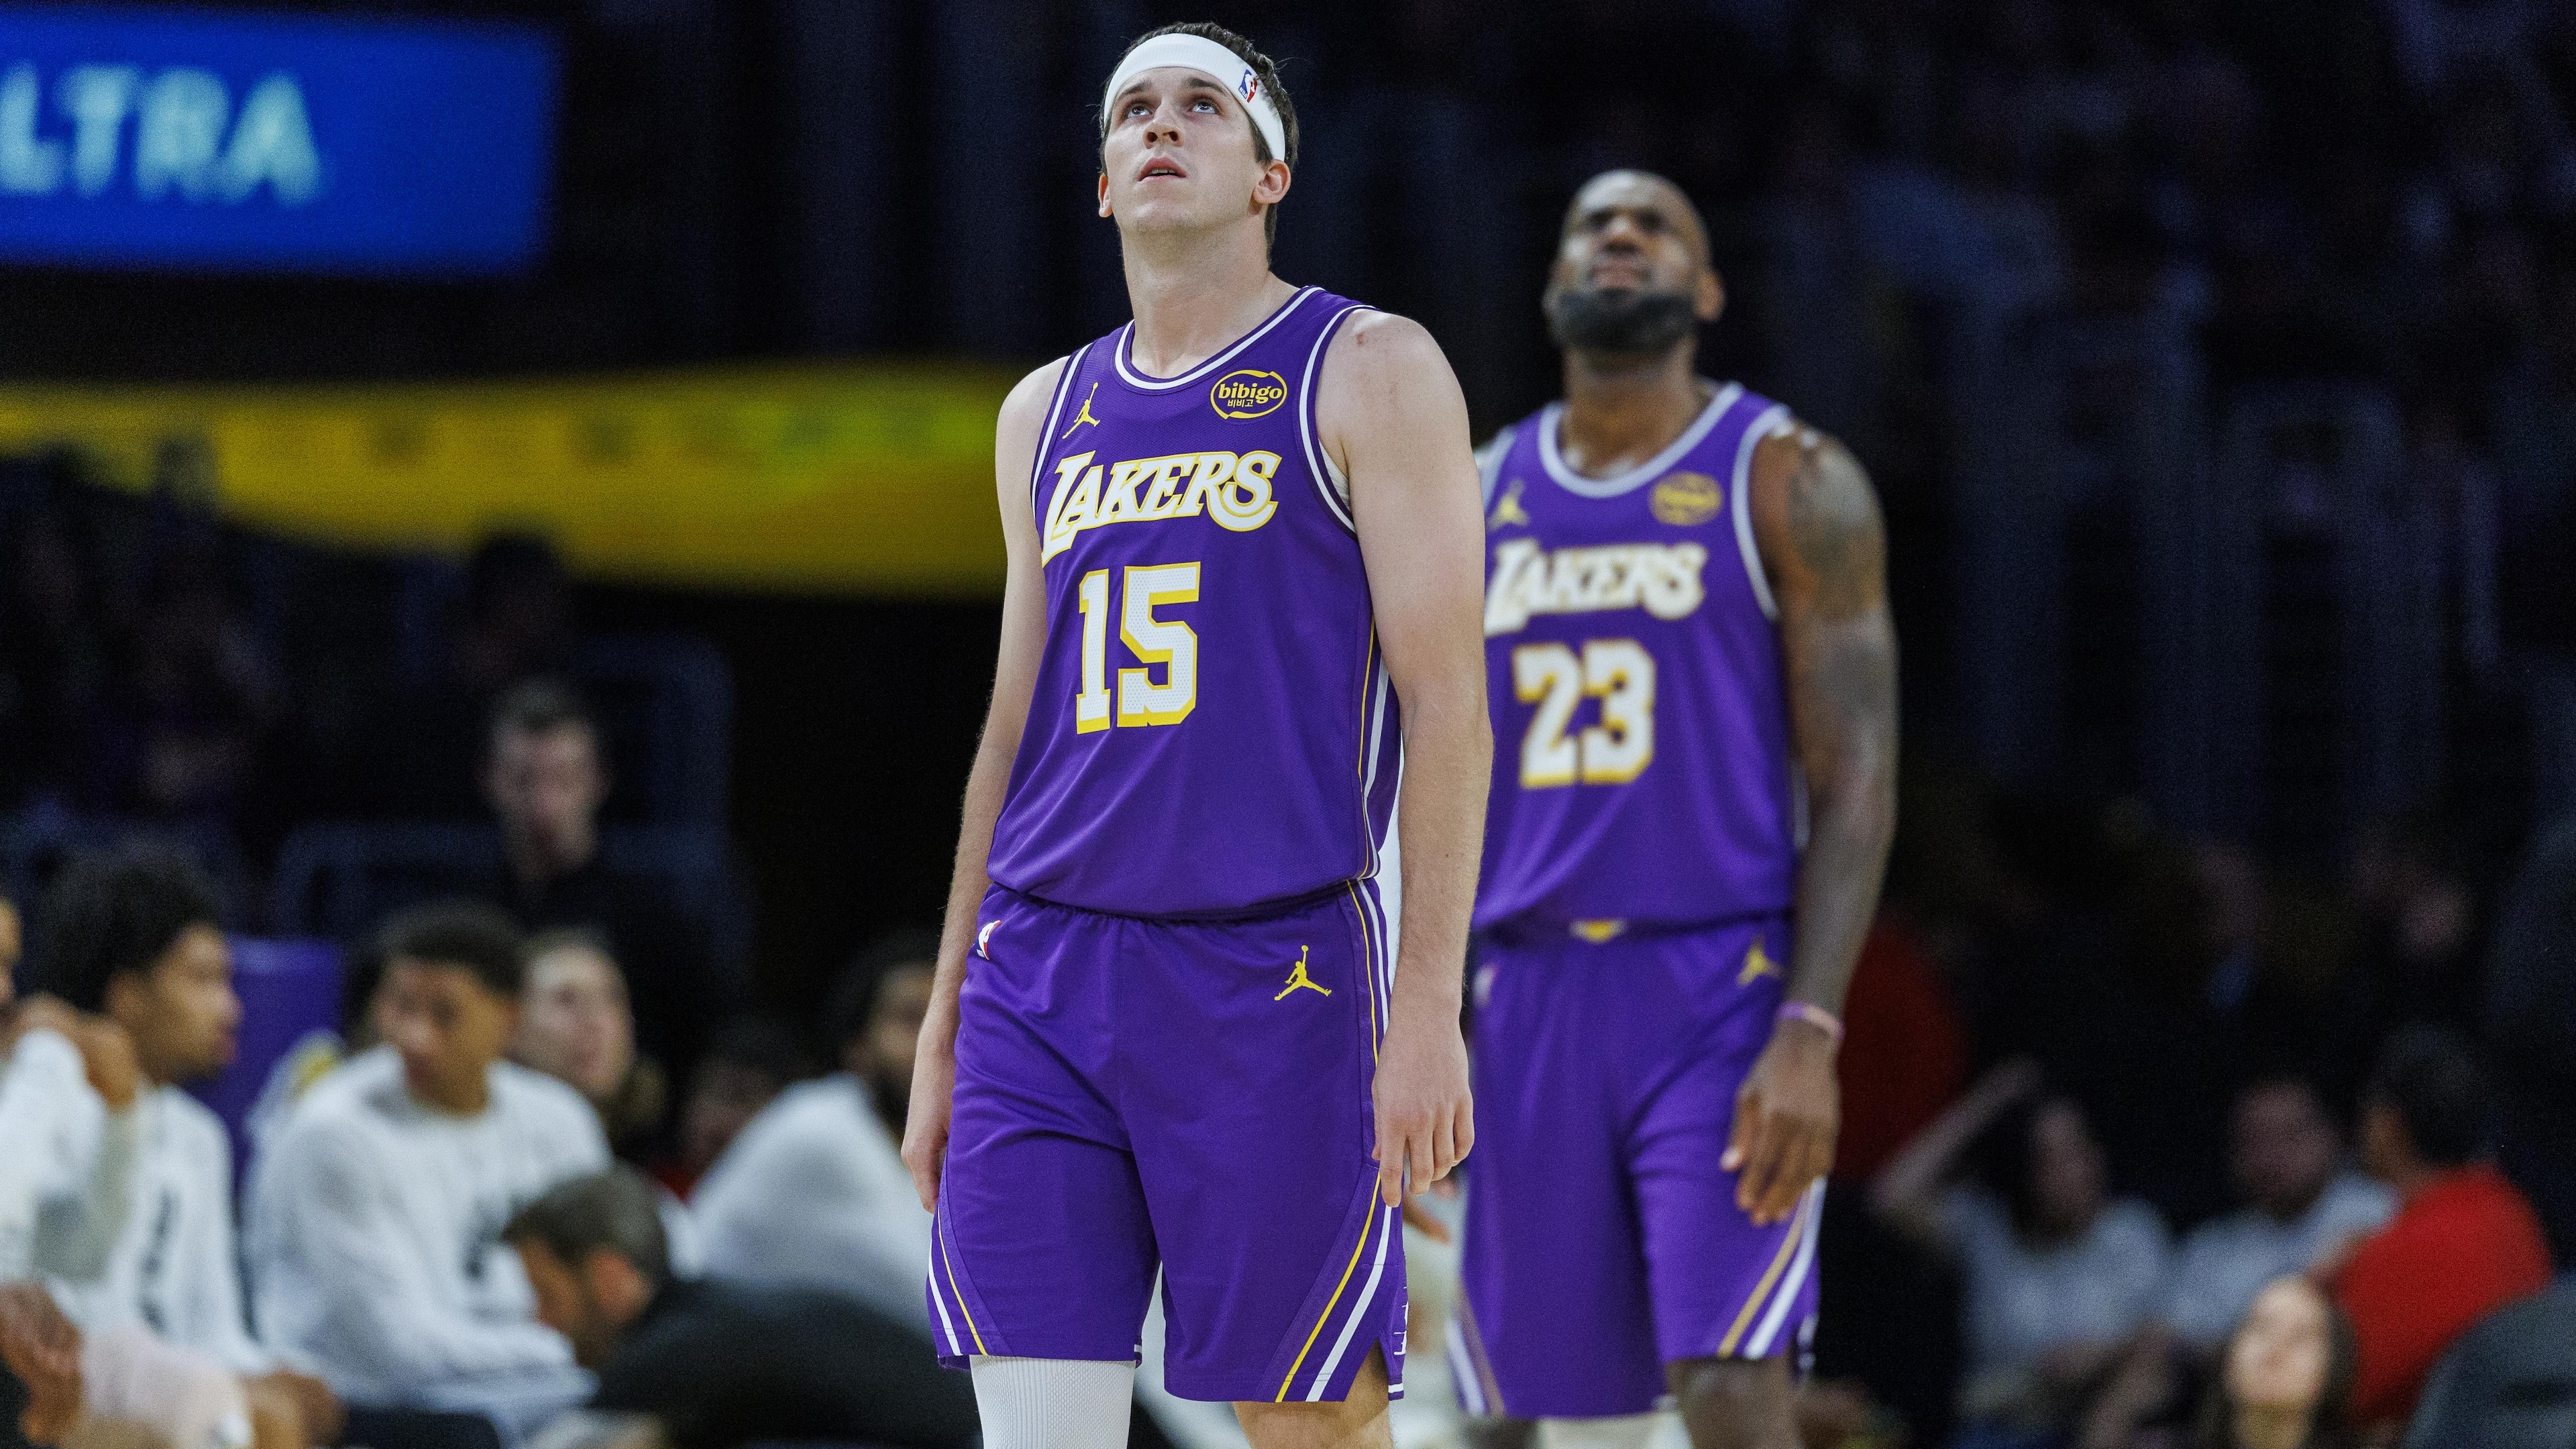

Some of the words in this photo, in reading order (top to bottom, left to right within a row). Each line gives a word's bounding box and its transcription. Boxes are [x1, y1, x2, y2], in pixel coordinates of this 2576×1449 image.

[1238, 87, 1248, 99] NBA
[1218, 382, 1282, 404] bibigo
[1227, 399, 1254, 408] 비비고
[1042, 450, 1282, 568] LAKERS
[1076, 561, 1201, 735] 15
[1513, 638, 1656, 788] 23
